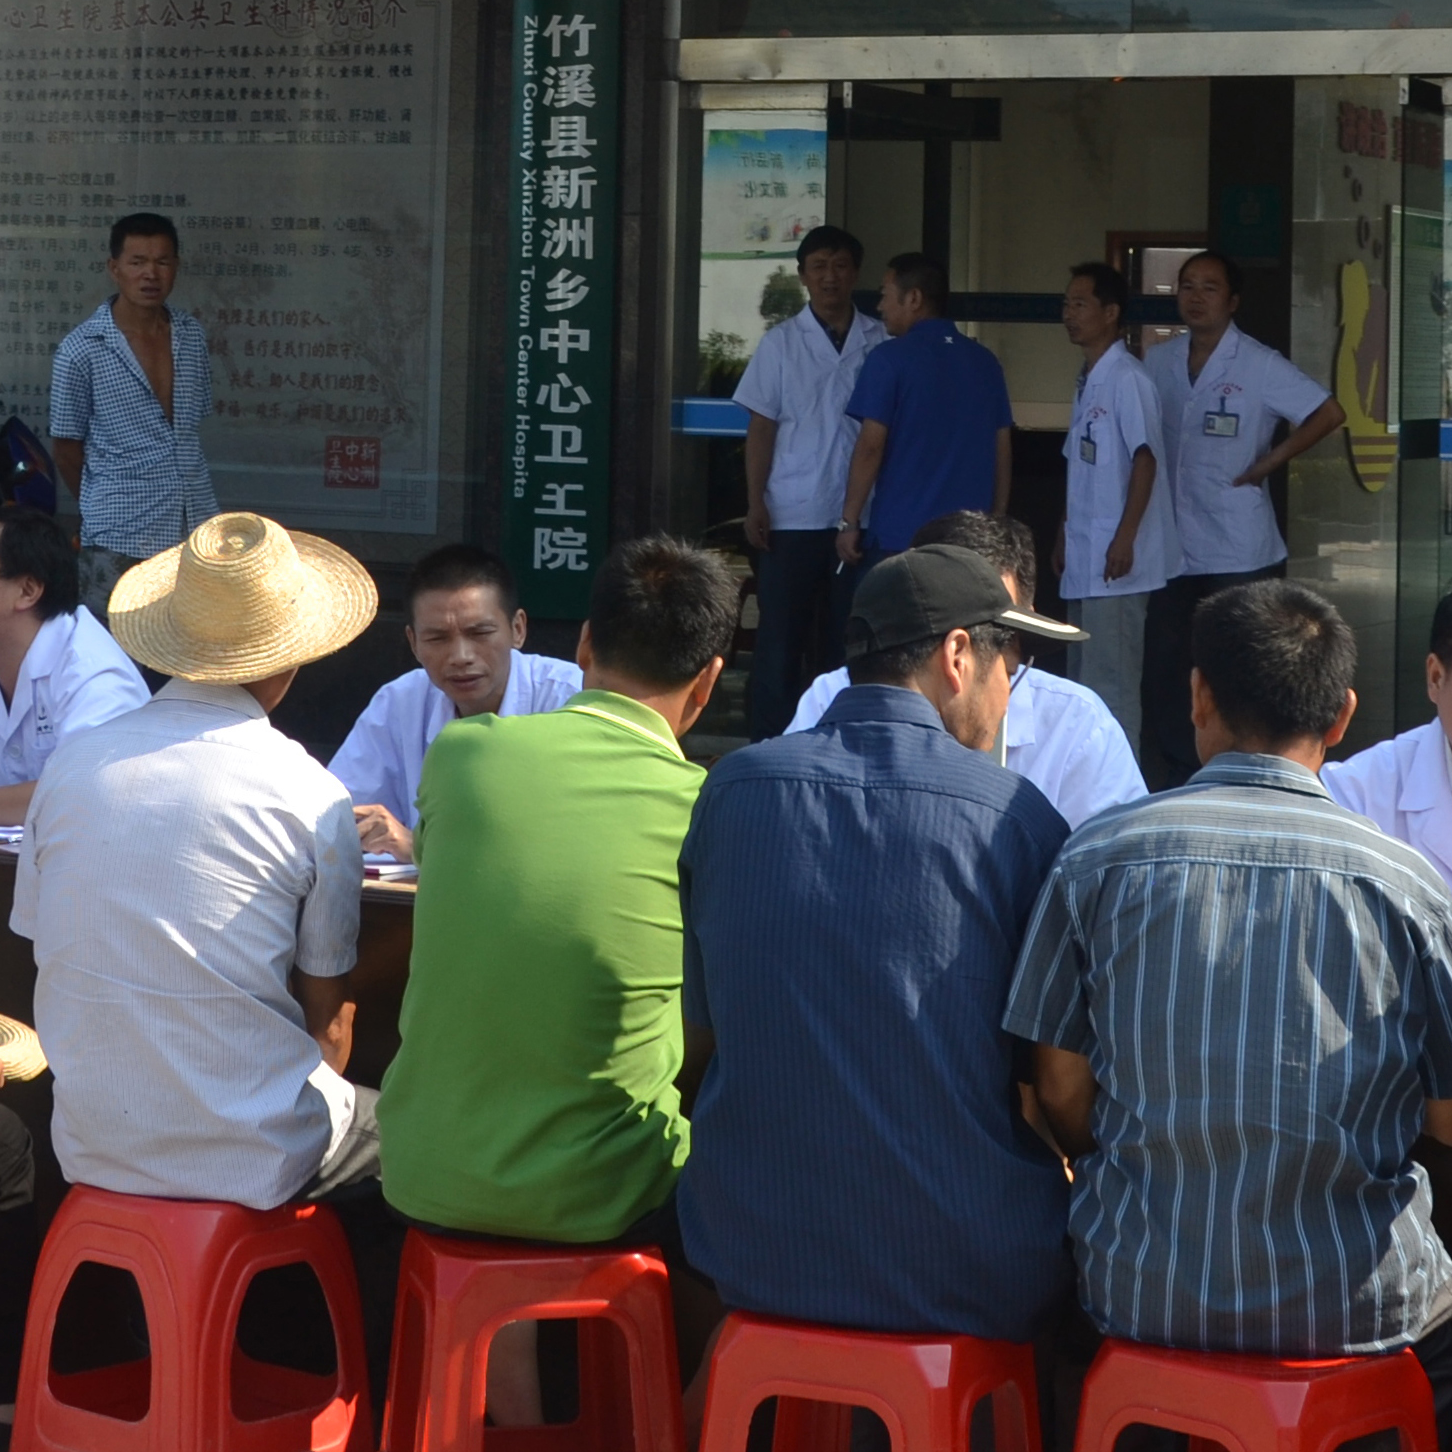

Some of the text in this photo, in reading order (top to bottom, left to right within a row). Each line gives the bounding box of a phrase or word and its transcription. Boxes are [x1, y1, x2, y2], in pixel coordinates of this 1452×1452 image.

[512, 14, 539, 498] Zhuxi County Xinzhou Town Center Hospita
[533, 14, 598, 571] 竹溪县新洲乡中心卫生院
